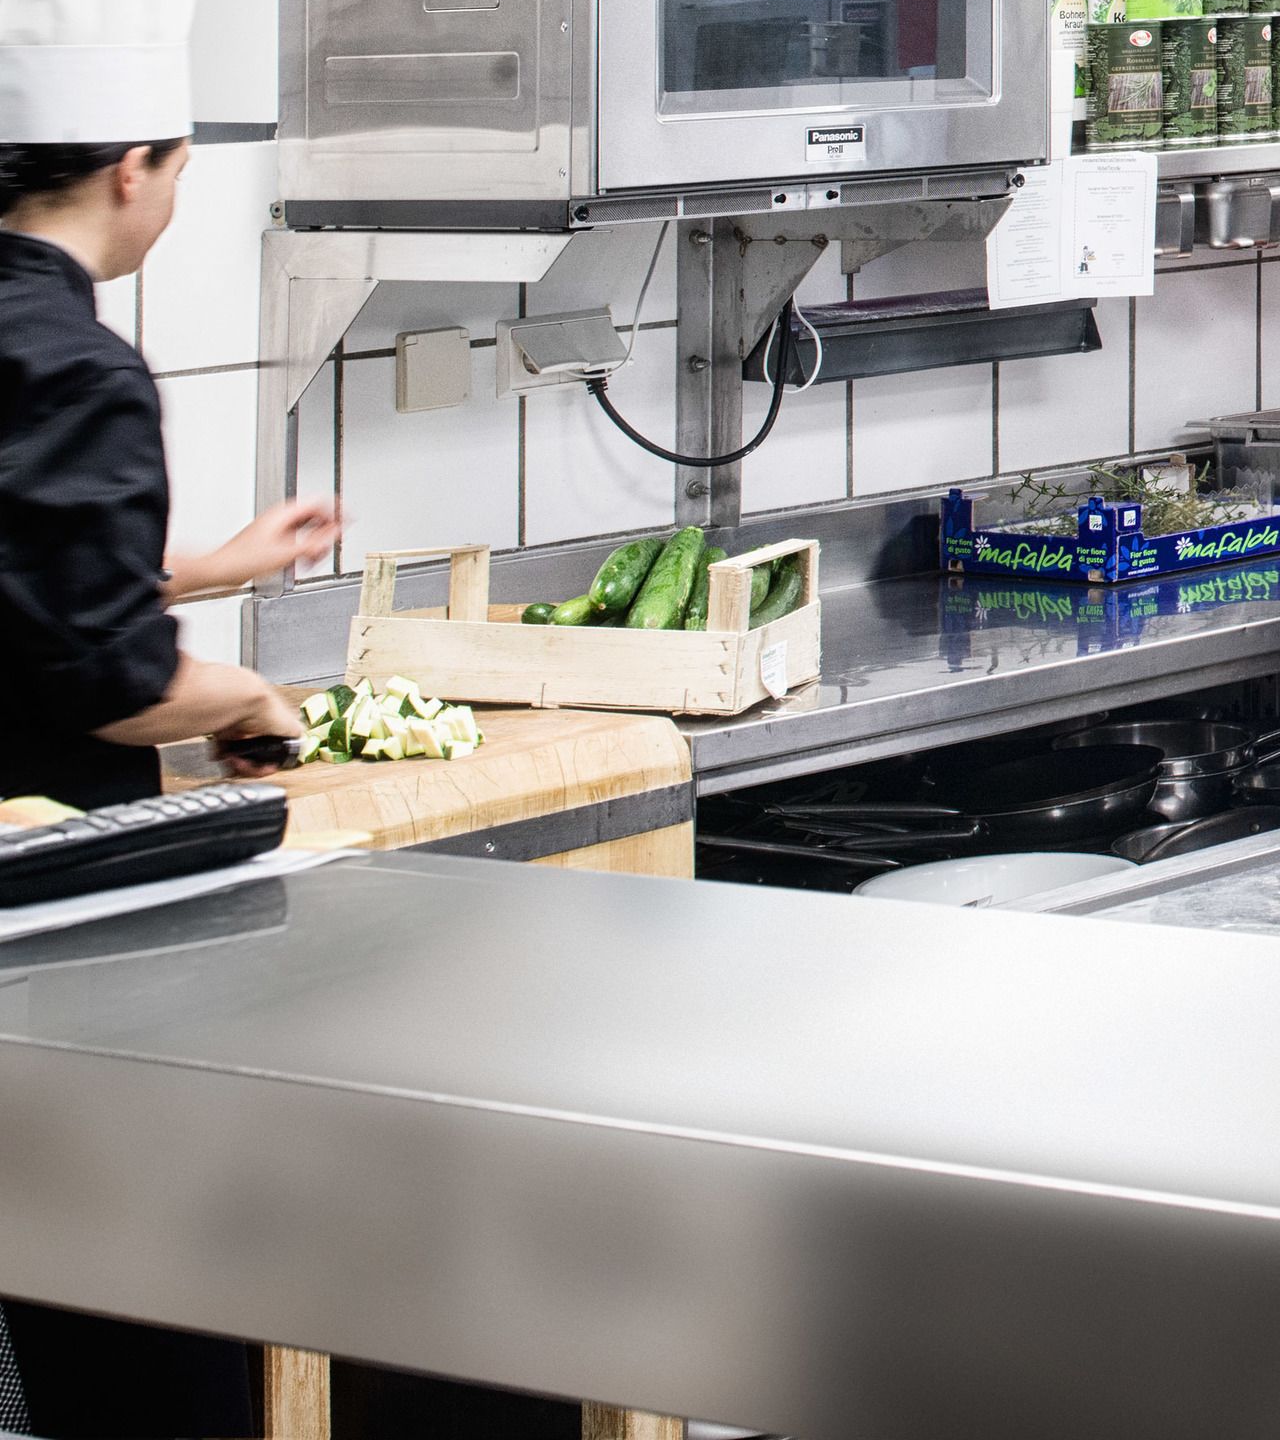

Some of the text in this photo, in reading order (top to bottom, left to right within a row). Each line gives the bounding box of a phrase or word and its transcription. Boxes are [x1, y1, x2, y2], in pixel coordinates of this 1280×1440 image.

[1059, 10, 1086, 20] Bohnen-
[1064, 20, 1083, 29] kraut
[812, 130, 858, 142] Panasonic
[946, 536, 972, 547] Fior fiore
[1179, 525, 1280, 561] mafalda
[954, 546, 972, 555] gusto
[1076, 546, 1106, 556] Fior fiore
[1130, 548, 1157, 559] Fior fiore
[978, 542, 1074, 572] mafalda
[1078, 555, 1104, 565] di gusto
[1132, 557, 1156, 567] di gusto
